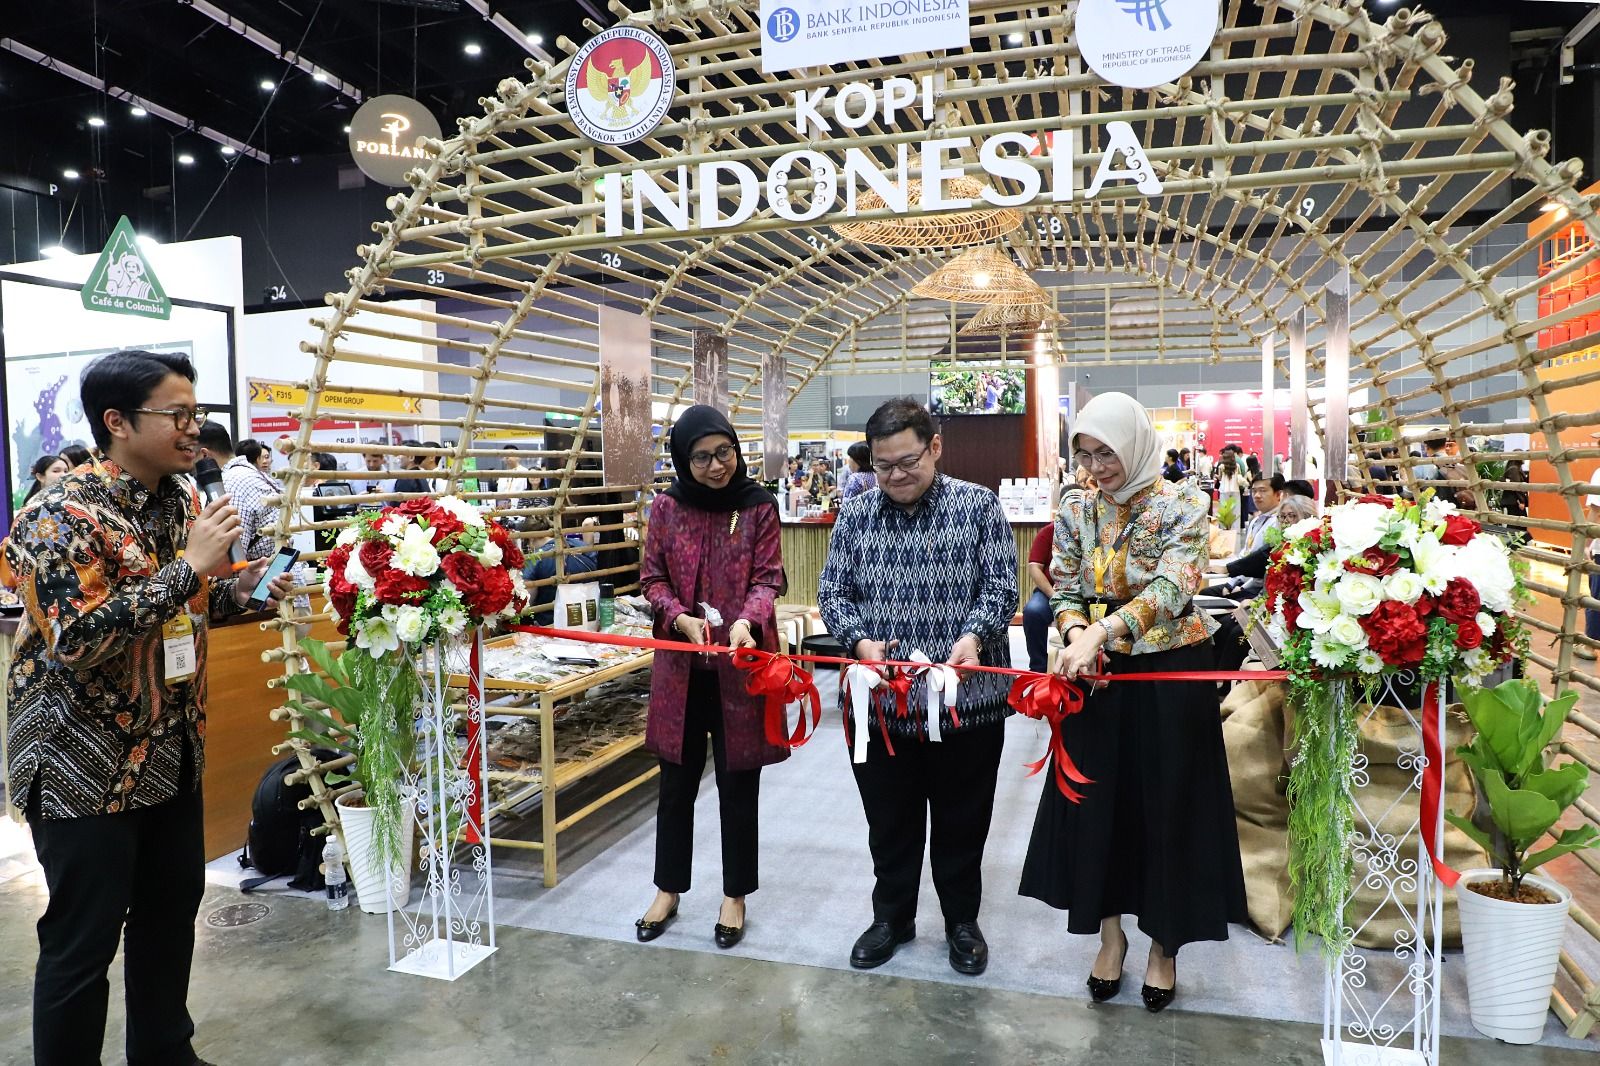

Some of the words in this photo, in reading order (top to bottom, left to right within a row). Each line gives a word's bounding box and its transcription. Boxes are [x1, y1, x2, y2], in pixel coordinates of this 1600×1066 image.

[807, 8, 853, 29] BANK
[859, 0, 960, 22] INDONESIA
[806, 30, 829, 40] BANK
[831, 24, 867, 36] SENTRAL
[870, 19, 910, 31] REPUBLIK
[912, 11, 961, 25] INDONESIA
[1102, 49, 1144, 61] MINISTRY
[1146, 47, 1159, 56] OF
[1160, 44, 1192, 54] TRADE
[1102, 59, 1137, 69] REPUBLIC
[1139, 57, 1149, 65] OF
[1150, 53, 1191, 63] INDONESIA
[567, 67, 578, 111] EMBASSY
[574, 52, 585, 66] OF
[583, 36, 601, 54] THE
[600, 28, 645, 42] REPUBLIC
[643, 35, 656, 47] OF
[652, 42, 673, 95] INDONESIA
[796, 75, 935, 133] KOPI
[576, 117, 616, 143] BANGKOK
[622, 105, 664, 141] THAILAND
[603, 120, 1163, 237] INDONESIA
[49, 183, 58, 196] P
[602, 253, 622, 268] 36
[427, 269, 445, 285] 35
[91, 295, 113, 307] Café
[114, 299, 124, 308] de
[125, 300, 165, 314] Colombia
[276, 390, 293, 400] F315
[344, 396, 365, 405] GROUP
[835, 405, 849, 417] 37
